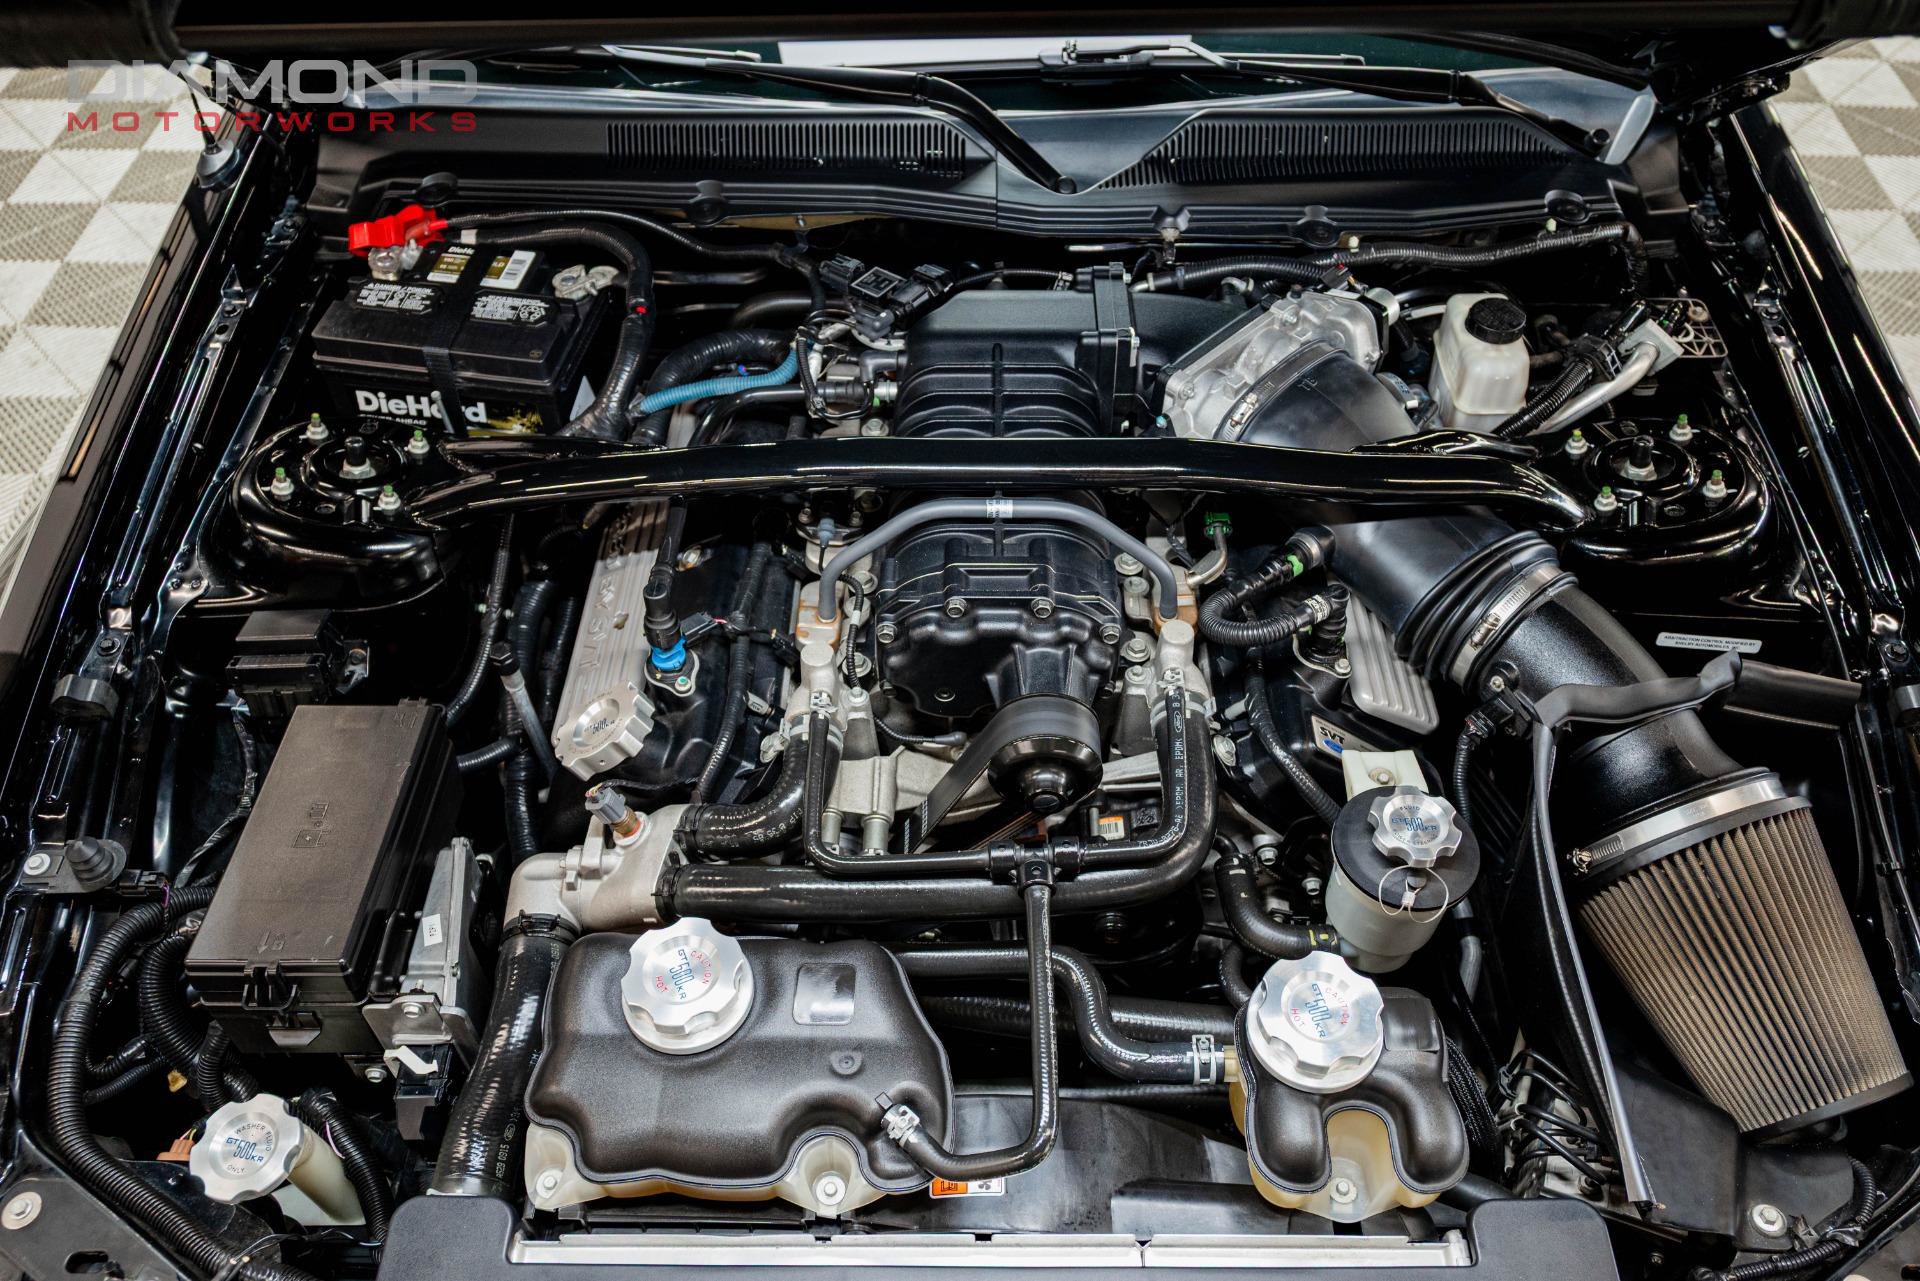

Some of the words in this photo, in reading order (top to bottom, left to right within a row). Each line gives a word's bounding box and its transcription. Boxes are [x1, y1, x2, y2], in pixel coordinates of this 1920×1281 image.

[355, 389, 488, 424] DieHad
[1319, 726, 1346, 745] SVT
[1391, 816, 1437, 832] GT500KR
[669, 949, 695, 999] GT500KR
[690, 950, 712, 985] CAUTION
[655, 975, 669, 993] HOT
[1291, 1008, 1305, 1028] HOT
[1304, 983, 1332, 1038] GT500KR
[235, 1123, 265, 1134] WASHER
[225, 1136, 265, 1162] GT500KR
[227, 1164, 247, 1174] ONLY
